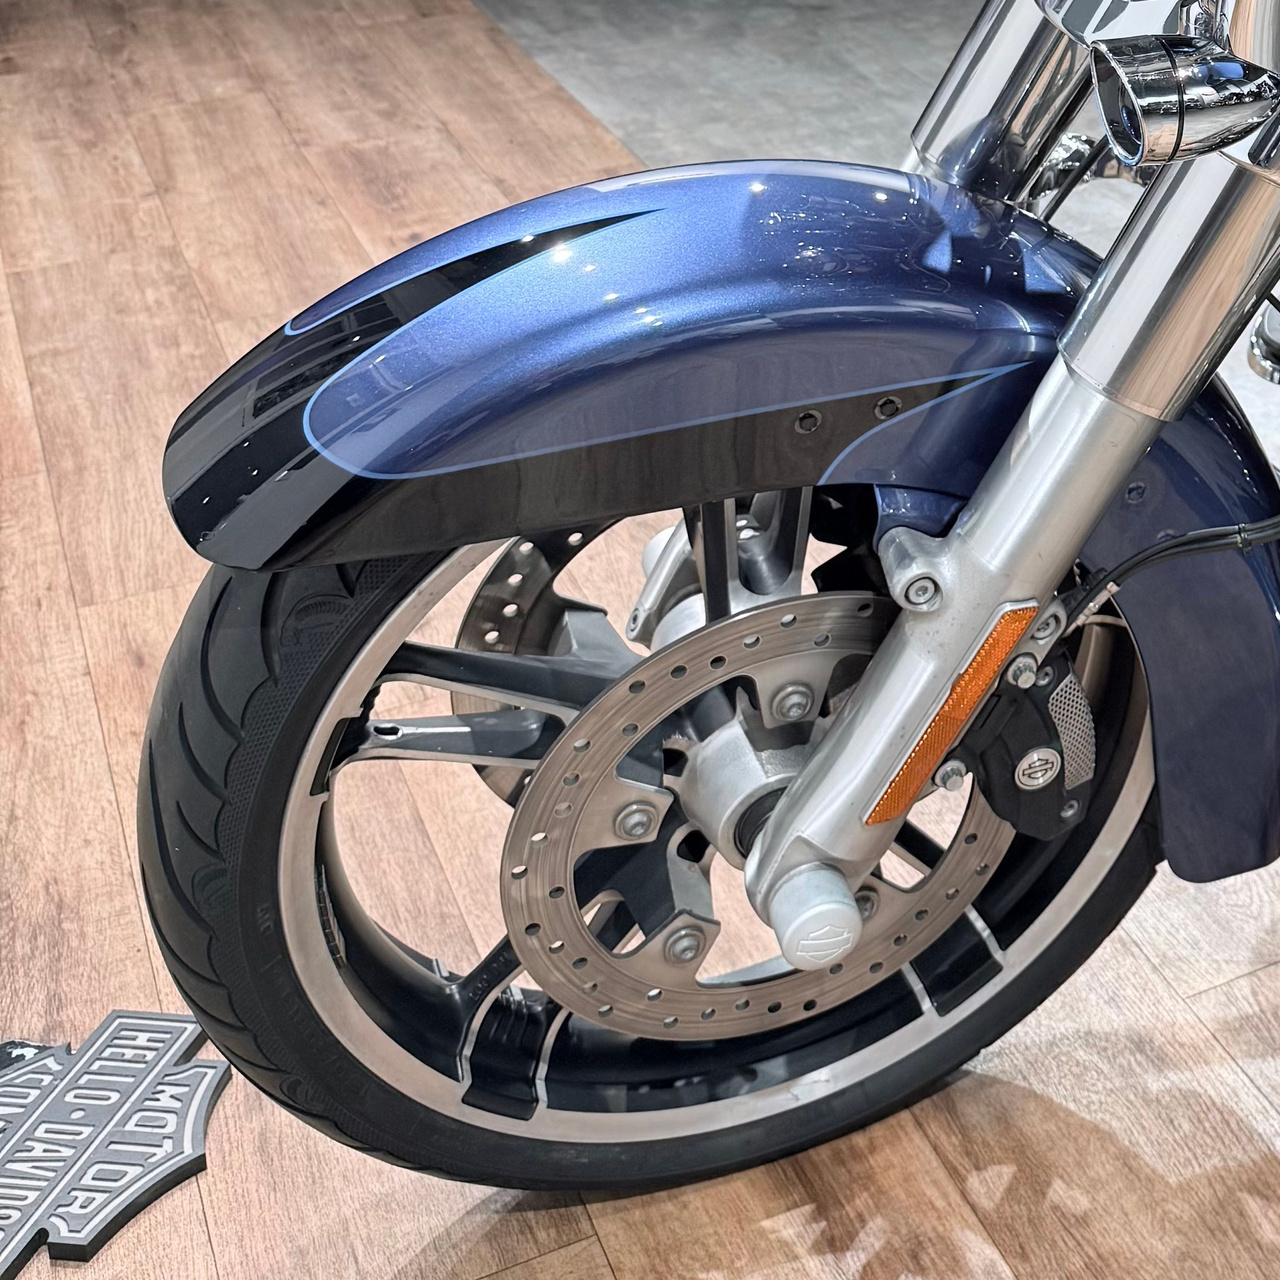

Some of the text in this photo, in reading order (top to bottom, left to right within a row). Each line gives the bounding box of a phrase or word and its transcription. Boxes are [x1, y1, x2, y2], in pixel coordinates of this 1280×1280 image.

[0, 1029, 172, 1240] HELLO DAVID
[55, 1084, 191, 1216] MOTOR
